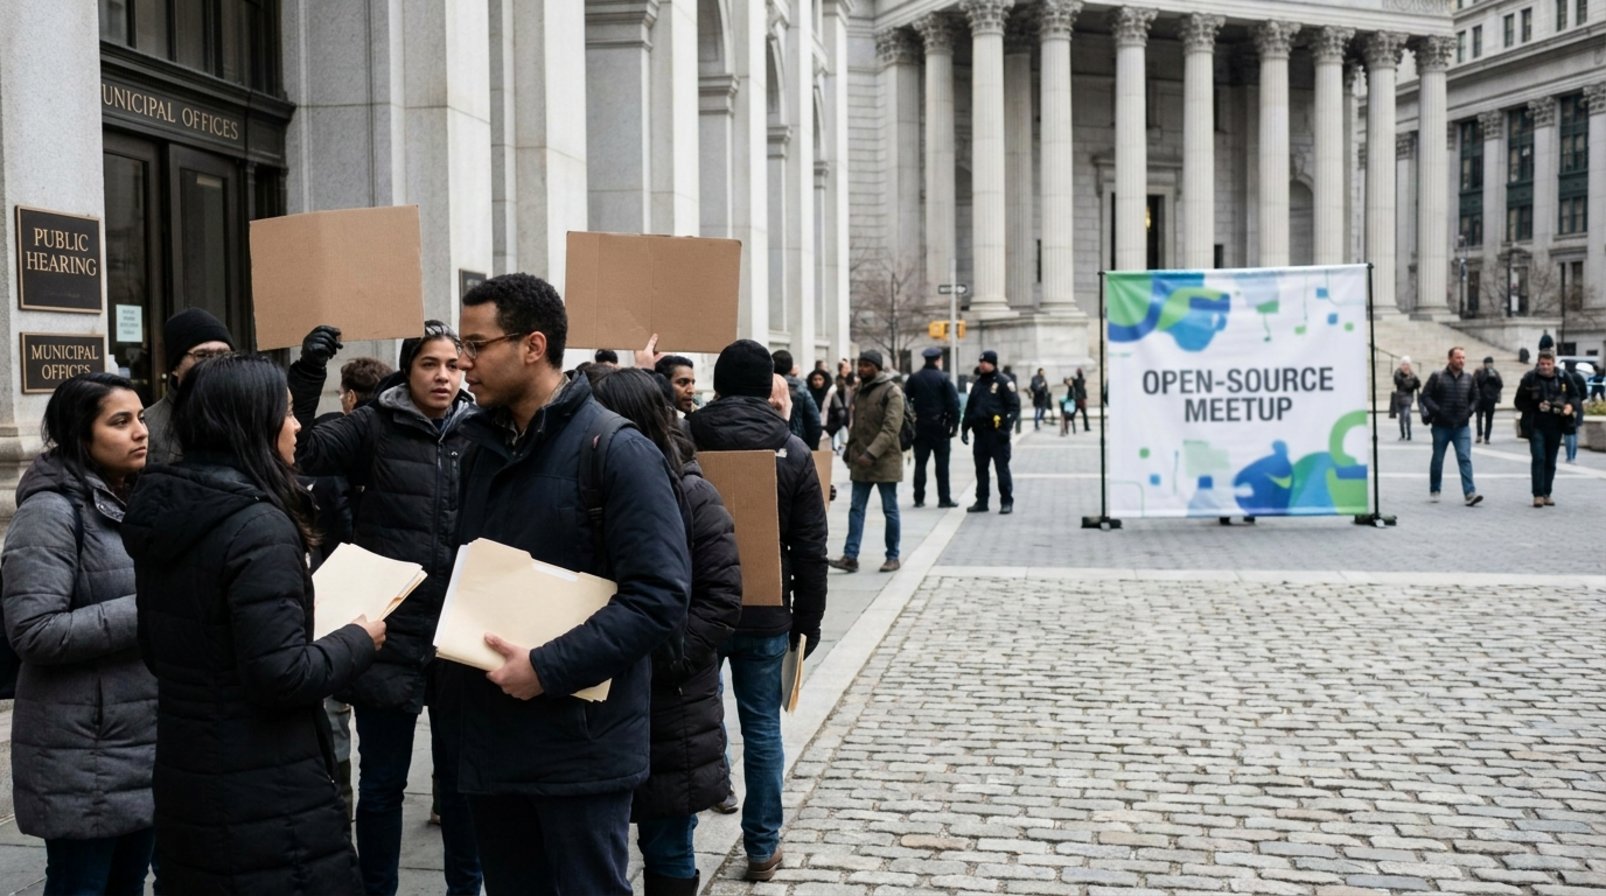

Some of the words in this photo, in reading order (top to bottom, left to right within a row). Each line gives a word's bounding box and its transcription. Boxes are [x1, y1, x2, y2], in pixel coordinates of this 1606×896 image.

[101, 84, 176, 123] UNICIPAL
[182, 107, 239, 139] OFFICES
[34, 227, 89, 252] PUBLIC
[26, 251, 97, 276] HEARING
[31, 345, 99, 360] MUNICIPAL
[1142, 367, 1334, 395] OPEN-SOURCE
[1185, 397, 1293, 422] MEETUP
